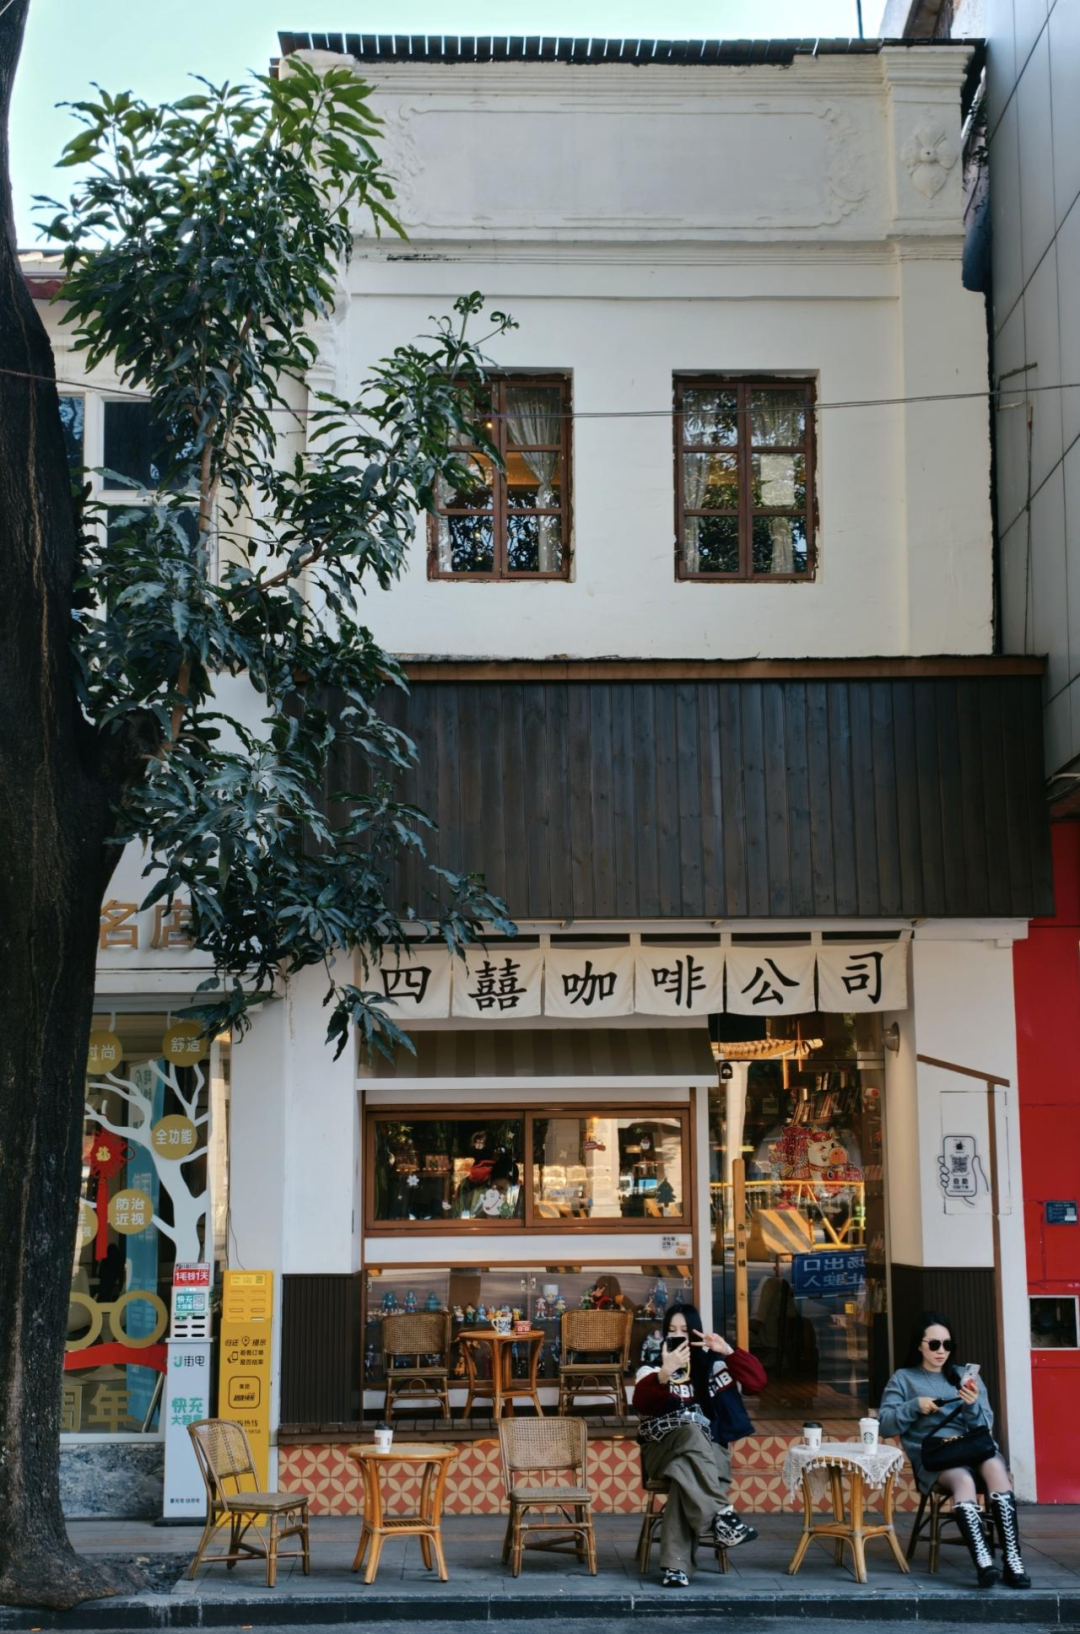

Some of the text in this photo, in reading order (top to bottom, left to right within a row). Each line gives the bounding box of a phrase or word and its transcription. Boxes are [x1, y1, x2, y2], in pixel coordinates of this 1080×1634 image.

[380, 951, 884, 1011] 四囍咖啡公司
[171, 1037, 200, 1052] 舒适
[156, 1129, 192, 1145] 全功能
[115, 1198, 145, 1211] 防治
[115, 1213, 145, 1226] 近视
[171, 1397, 203, 1414] 快充
